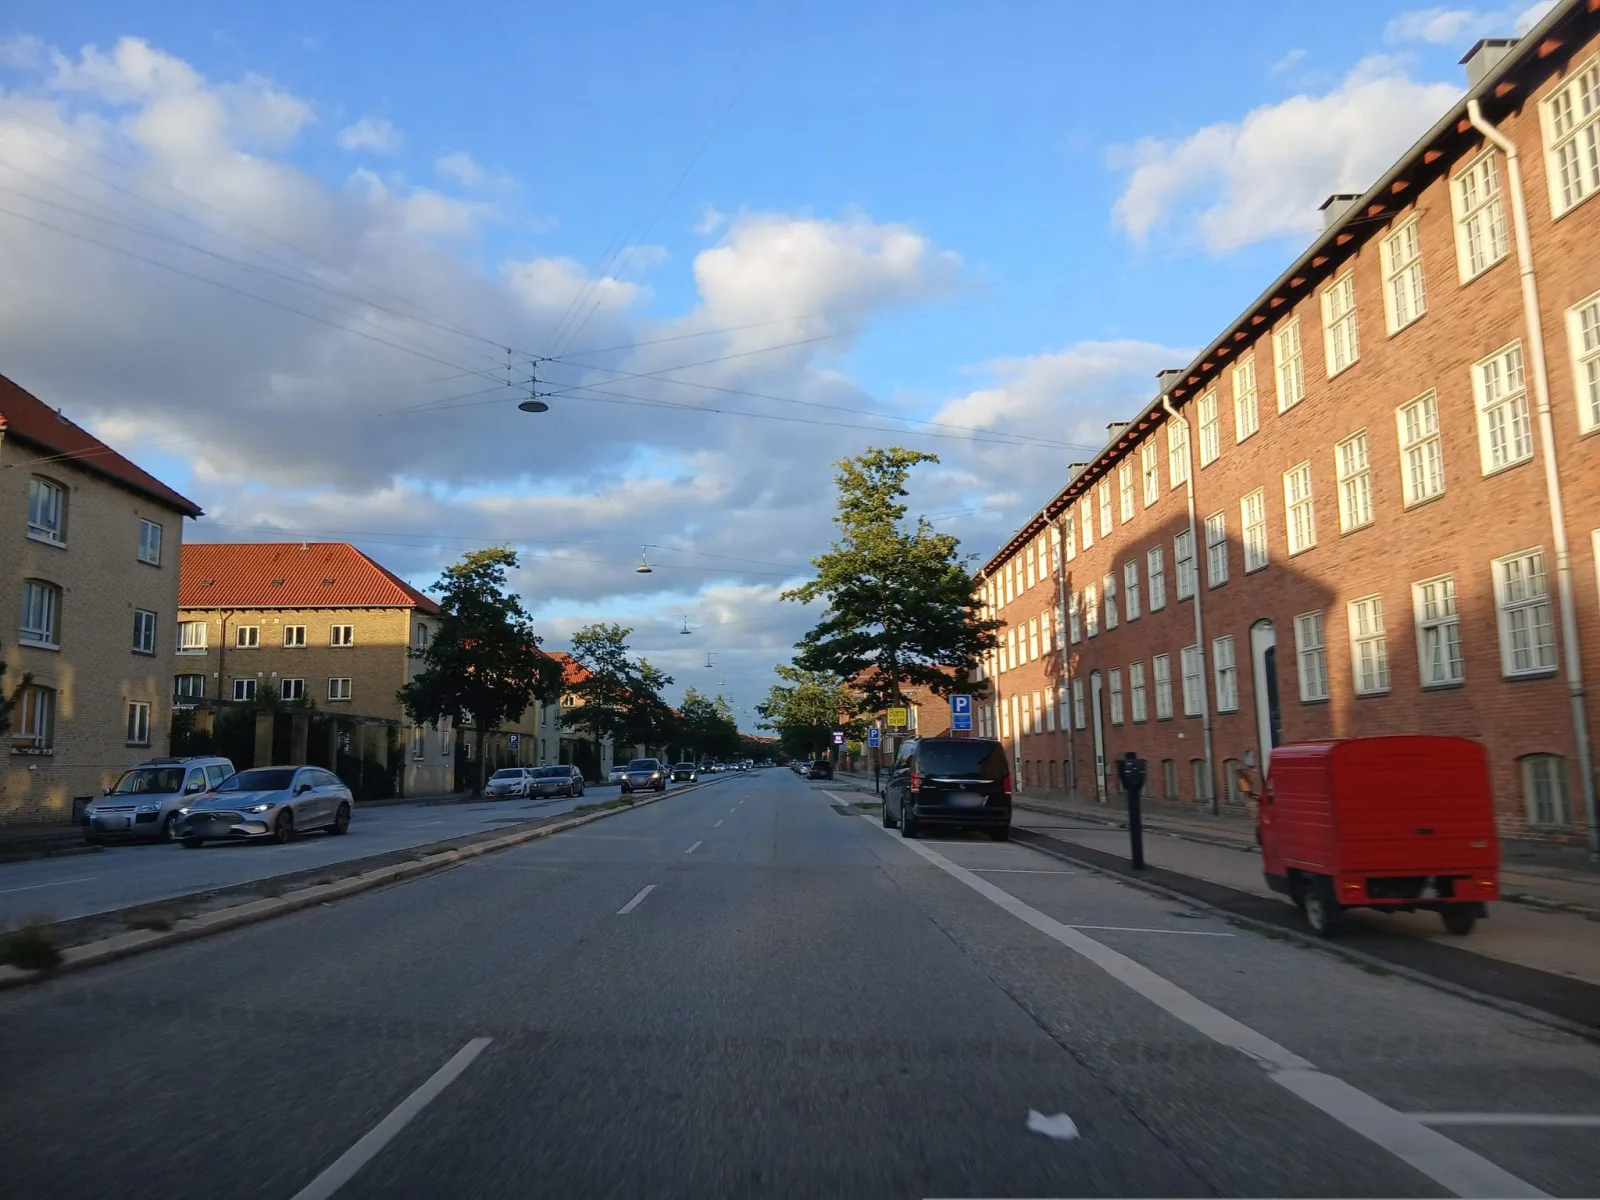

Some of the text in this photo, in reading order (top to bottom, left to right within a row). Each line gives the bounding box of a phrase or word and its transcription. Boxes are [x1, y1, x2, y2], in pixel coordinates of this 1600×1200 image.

[956, 697, 967, 711] P
[871, 730, 877, 738] P
[510, 735, 517, 743] P
